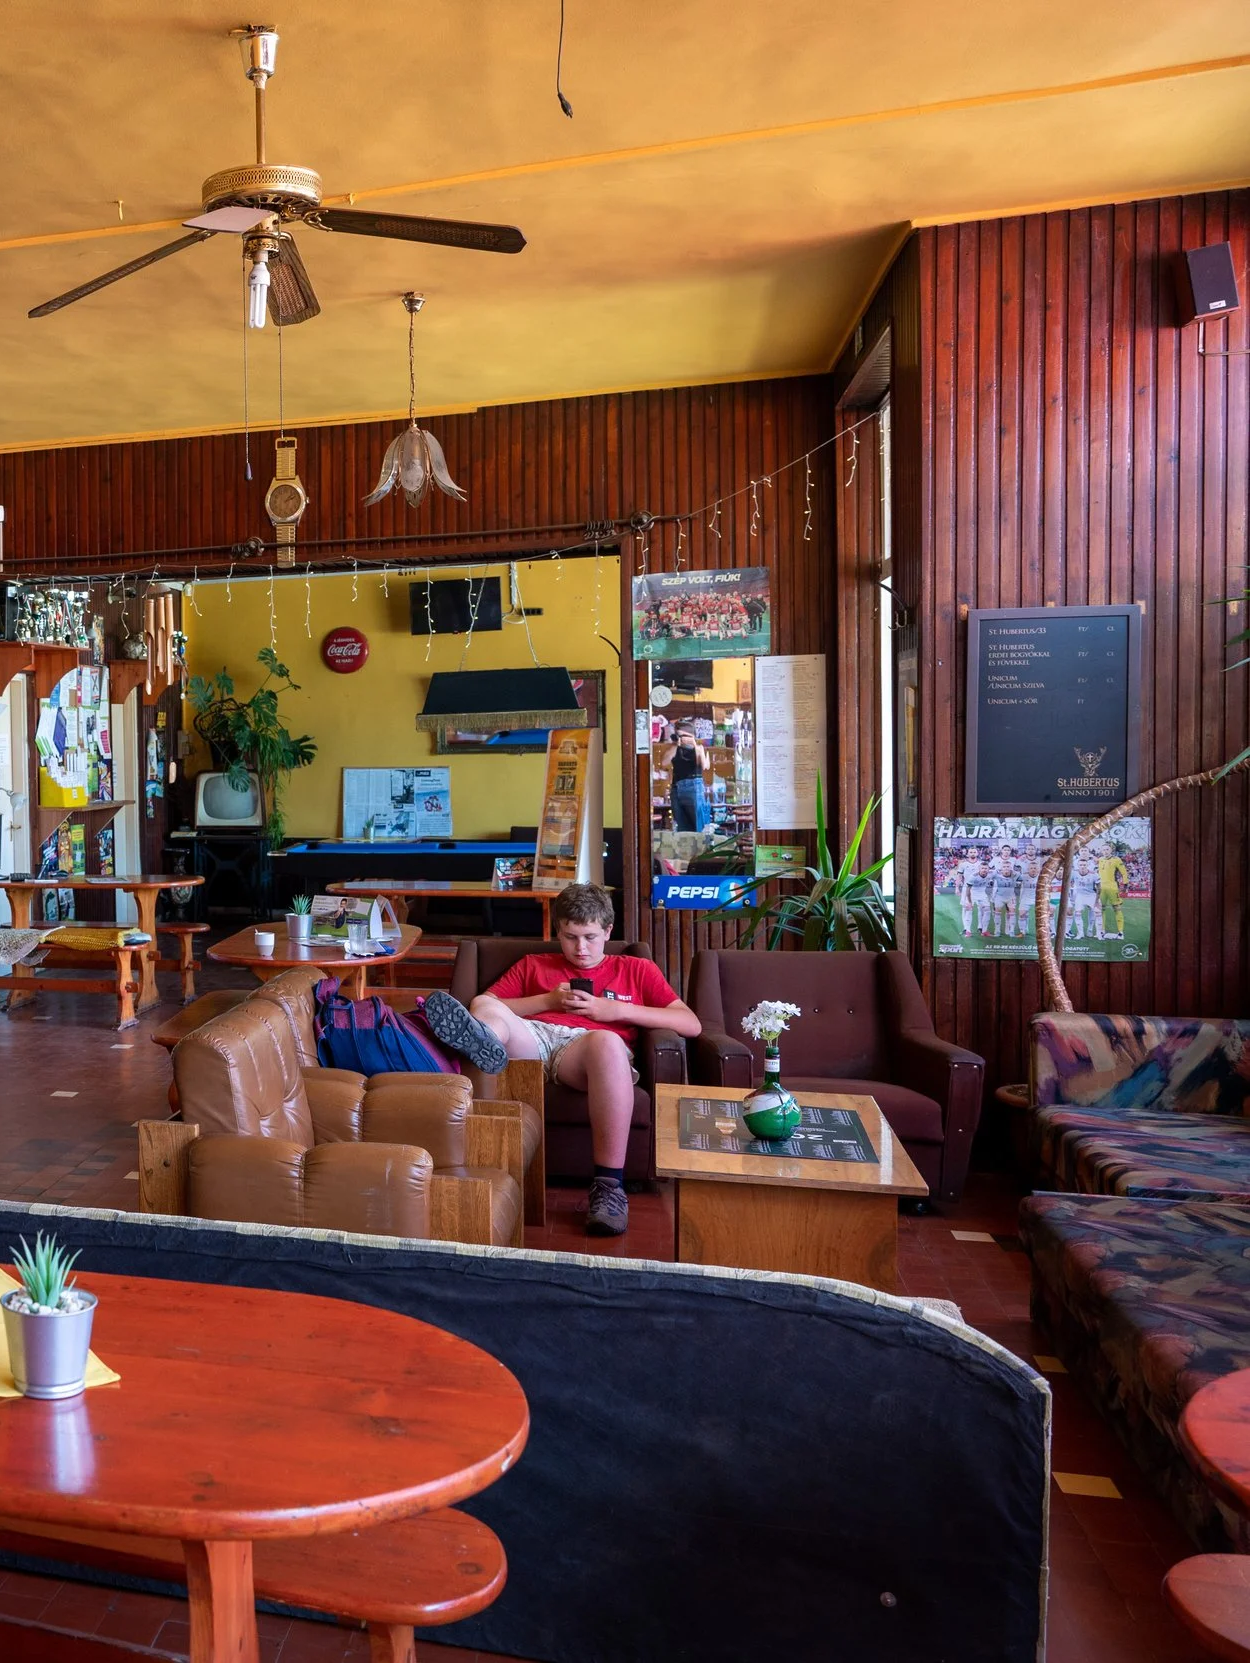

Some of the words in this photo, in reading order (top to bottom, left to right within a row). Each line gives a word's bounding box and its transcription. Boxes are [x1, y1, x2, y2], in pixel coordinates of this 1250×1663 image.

[661, 576, 686, 586] SZÉP
[688, 575, 714, 585] VOLT,
[715, 572, 741, 583] FIÚK!
[327, 643, 362, 657] Coca-Cola
[1057, 777, 1120, 787] St.HUBERTUS
[1093, 789, 1115, 797] 1901
[938, 821, 1013, 841] HAJRÁ,
[1018, 825, 1149, 839] MAGYOK!
[667, 885, 719, 899] PEPSI
